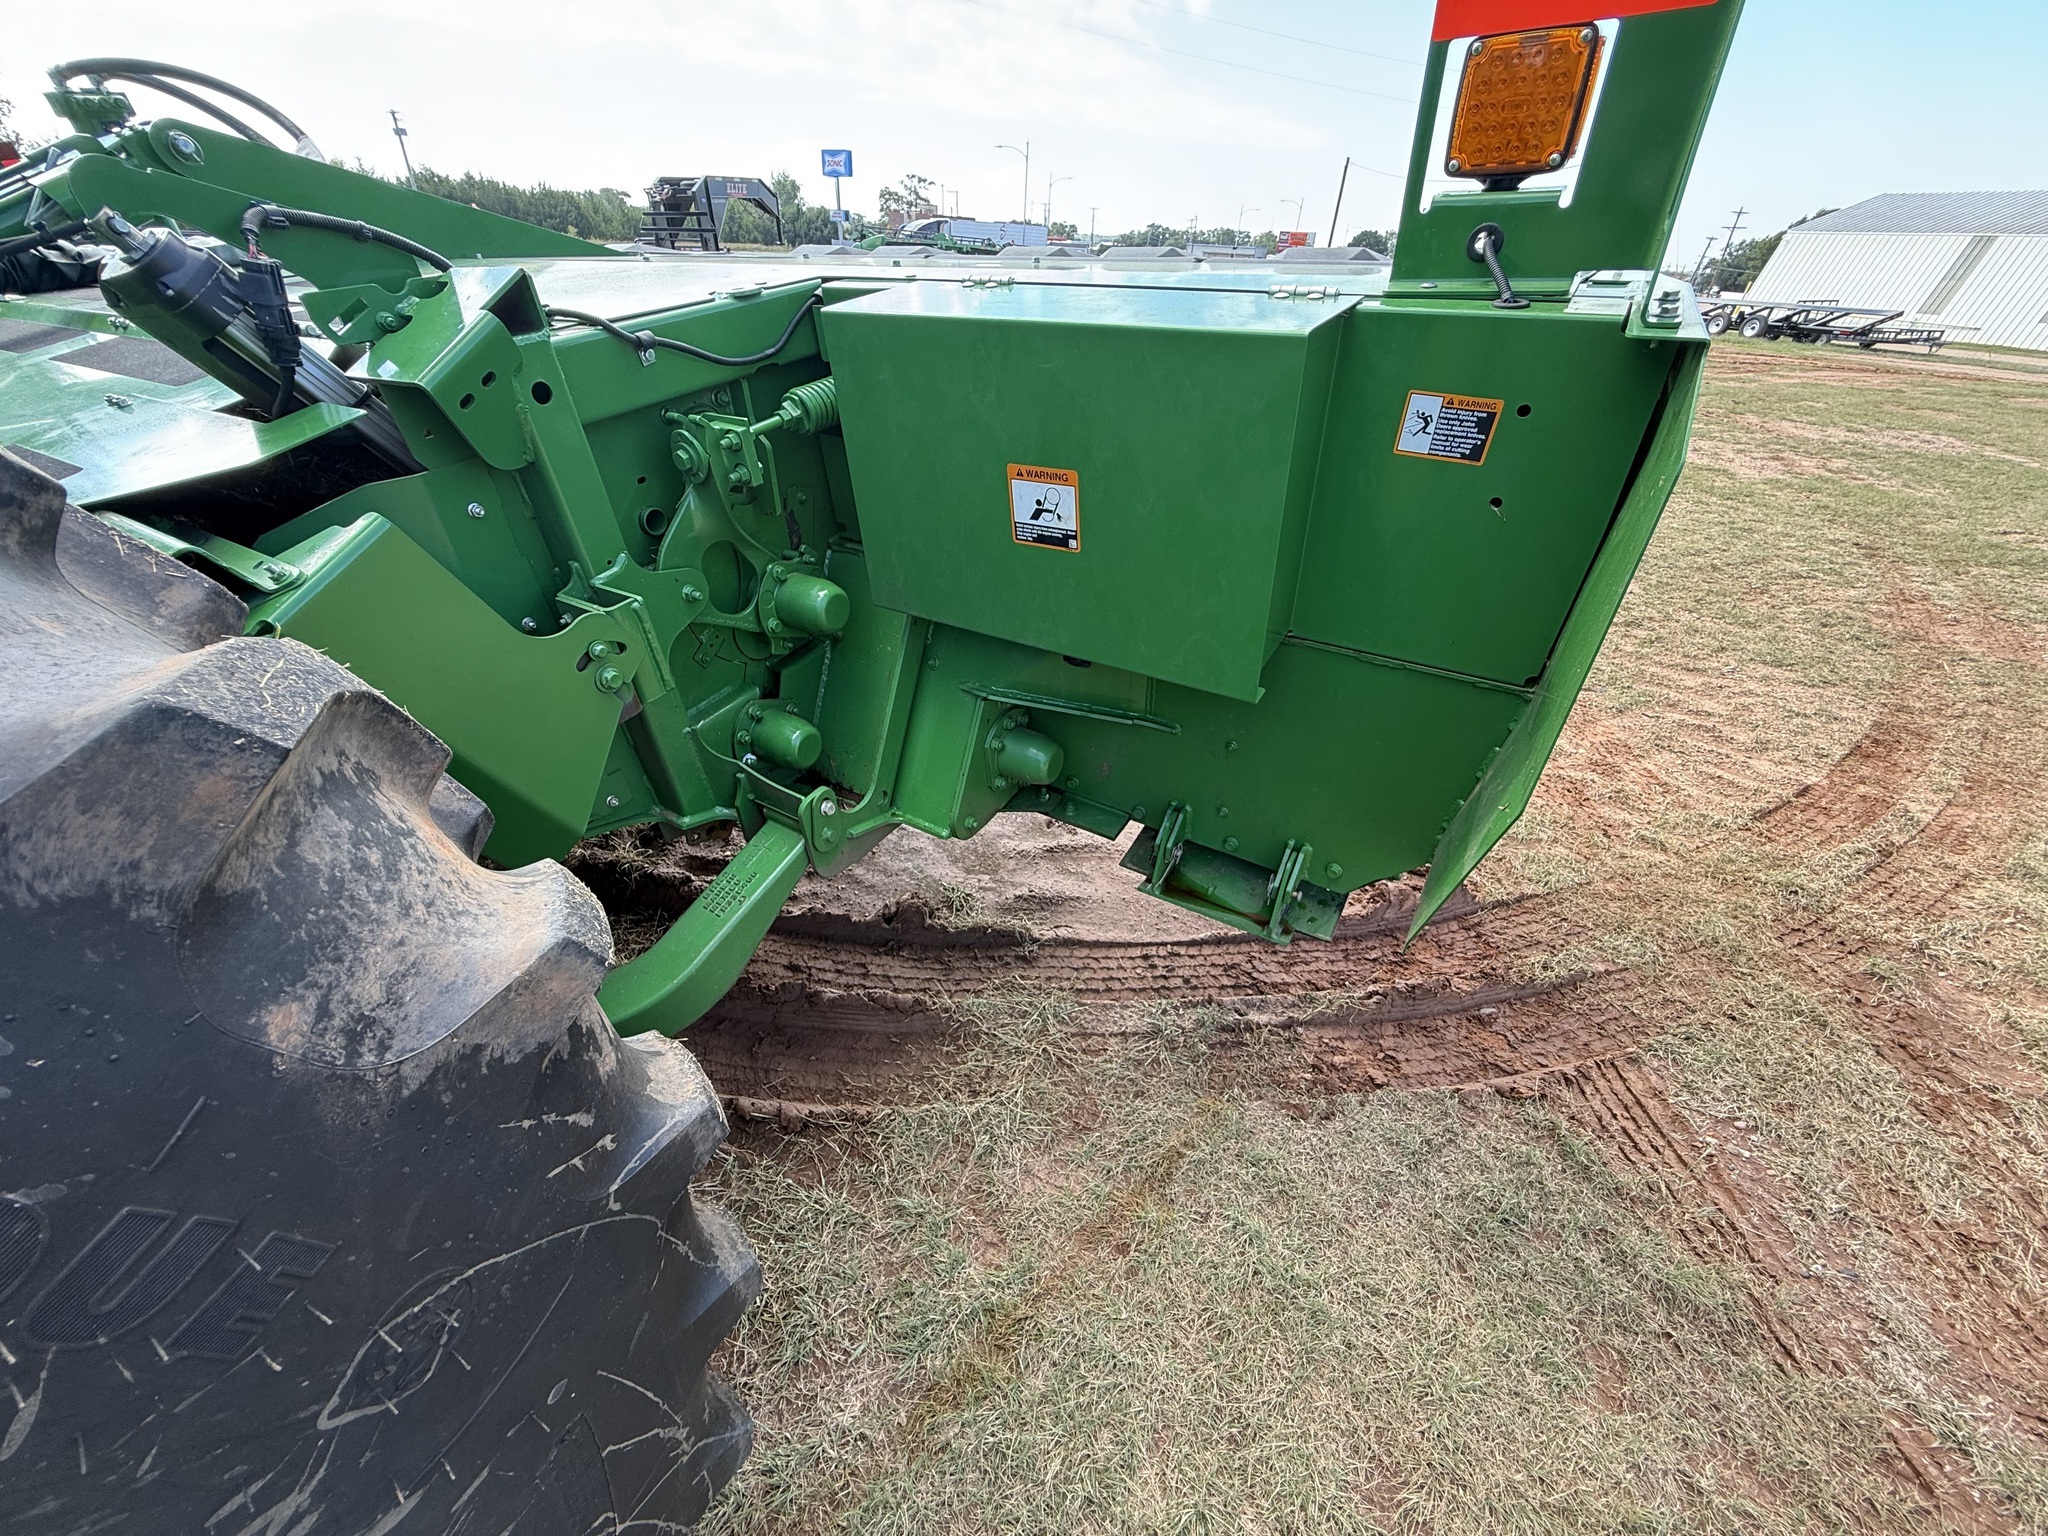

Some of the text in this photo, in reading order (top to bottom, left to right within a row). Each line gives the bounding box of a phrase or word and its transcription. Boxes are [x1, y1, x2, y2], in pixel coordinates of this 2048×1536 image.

[826, 159, 843, 168] SONIC
[726, 183, 748, 194] ELITE
[1457, 399, 1497, 410] WARNING
[1026, 469, 1068, 482] WARNING
[0, 1197, 337, 1362] UE
